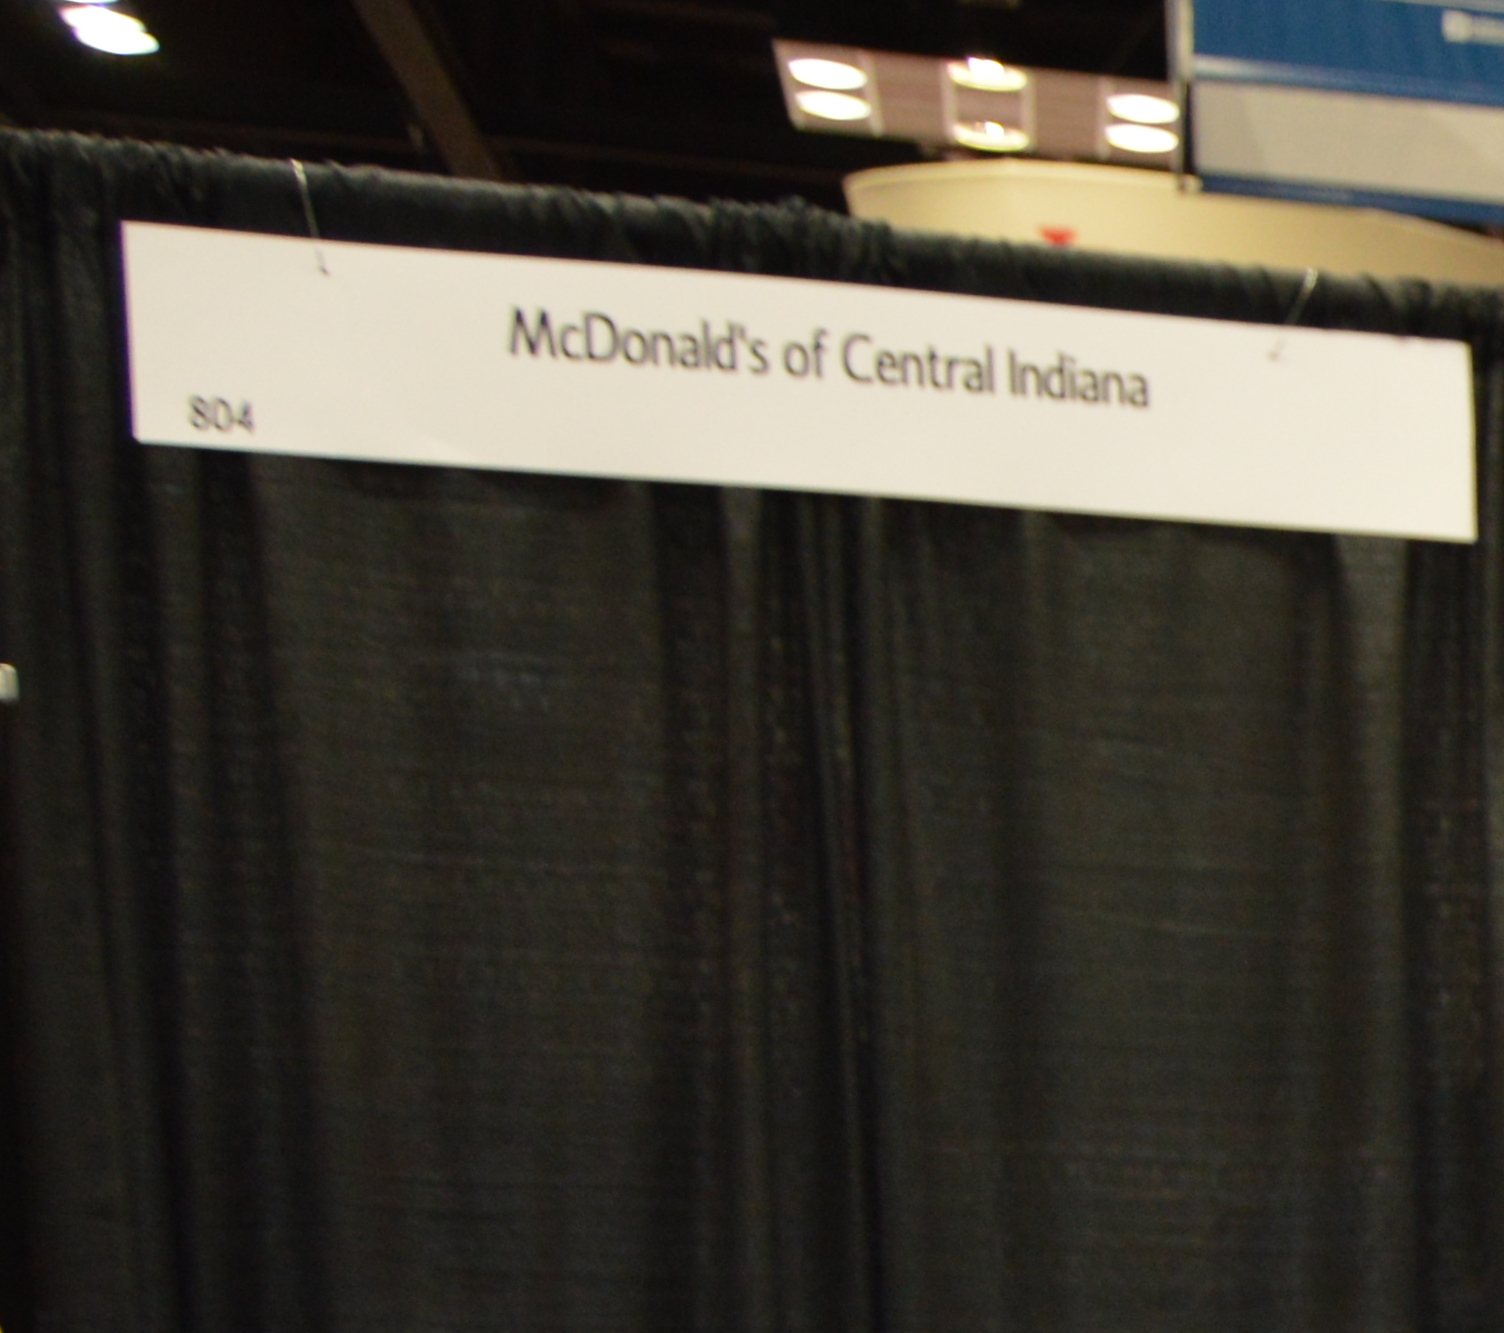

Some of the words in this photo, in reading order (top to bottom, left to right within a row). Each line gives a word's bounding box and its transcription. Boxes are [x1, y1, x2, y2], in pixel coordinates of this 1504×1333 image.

[508, 306, 769, 374] McDonald's
[783, 328, 828, 381] of
[842, 333, 995, 395] Central
[1008, 350, 1150, 409] Indiana
[188, 395, 256, 434] 804
